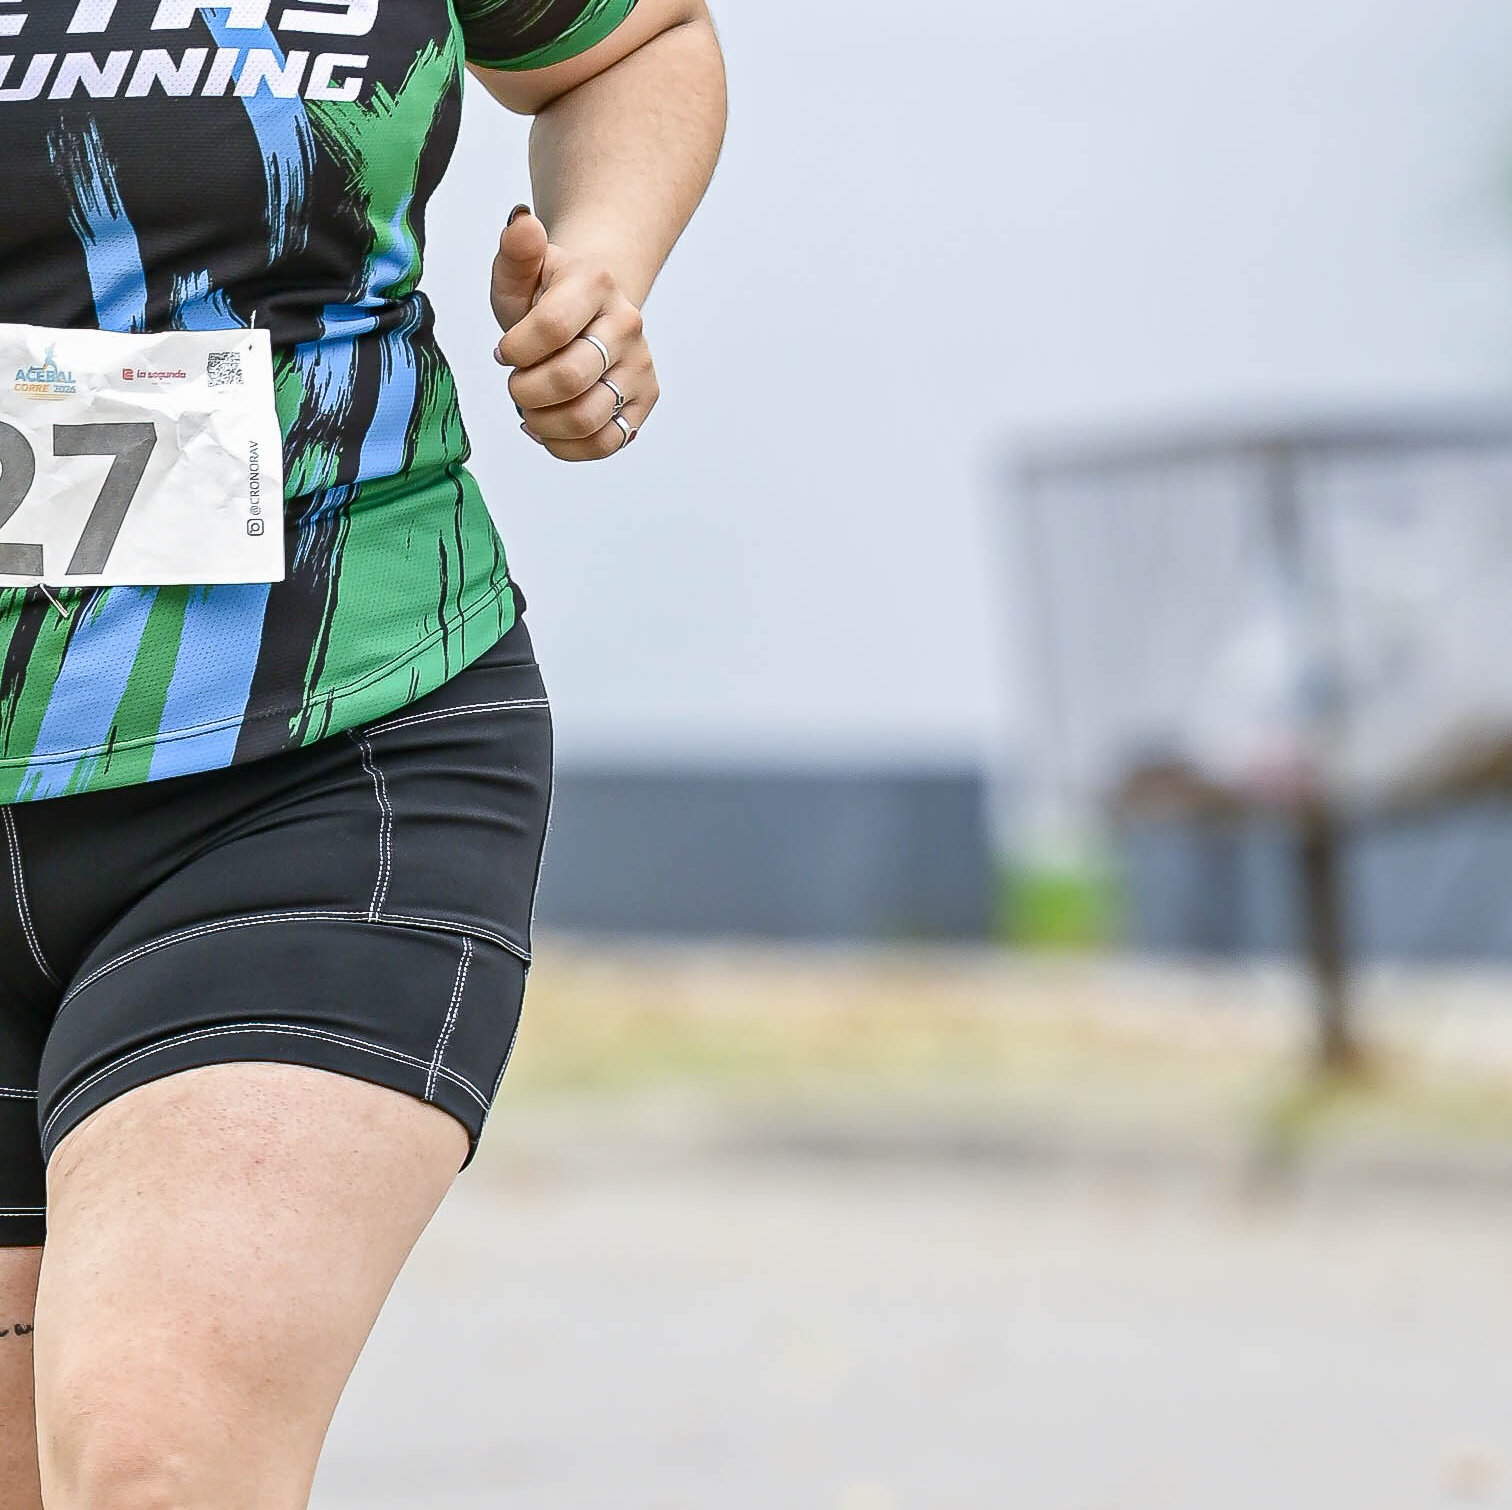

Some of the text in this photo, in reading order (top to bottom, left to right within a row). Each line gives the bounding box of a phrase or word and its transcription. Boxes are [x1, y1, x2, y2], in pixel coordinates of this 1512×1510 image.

[14, 368, 77, 384] ACEBAL
[147, 369, 187, 381] segunda
[14, 383, 50, 393] CORRE
[249, 440, 262, 516] @CRONORAV
